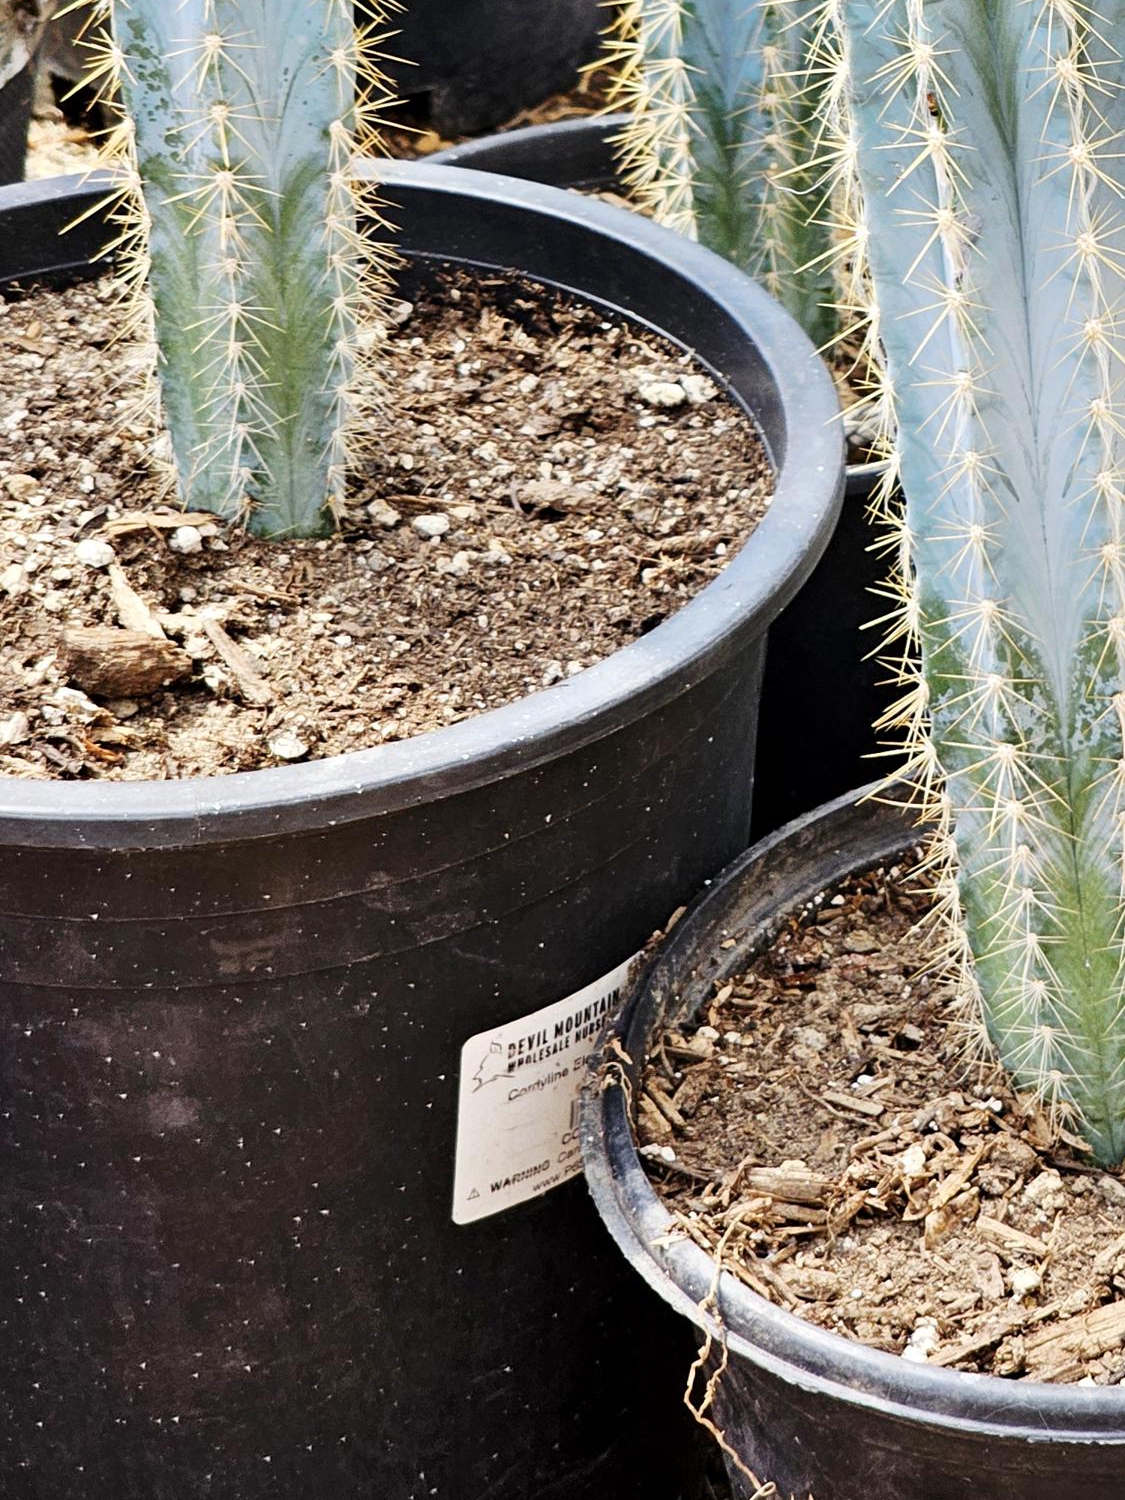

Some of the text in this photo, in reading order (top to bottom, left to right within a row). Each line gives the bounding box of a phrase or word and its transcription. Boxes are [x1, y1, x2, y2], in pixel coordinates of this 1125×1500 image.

[507, 987, 620, 1060] DEVIL MOUNTAIN
[507, 1037, 570, 1073] WHOLESALE
[508, 1067, 569, 1101] Cordyline
